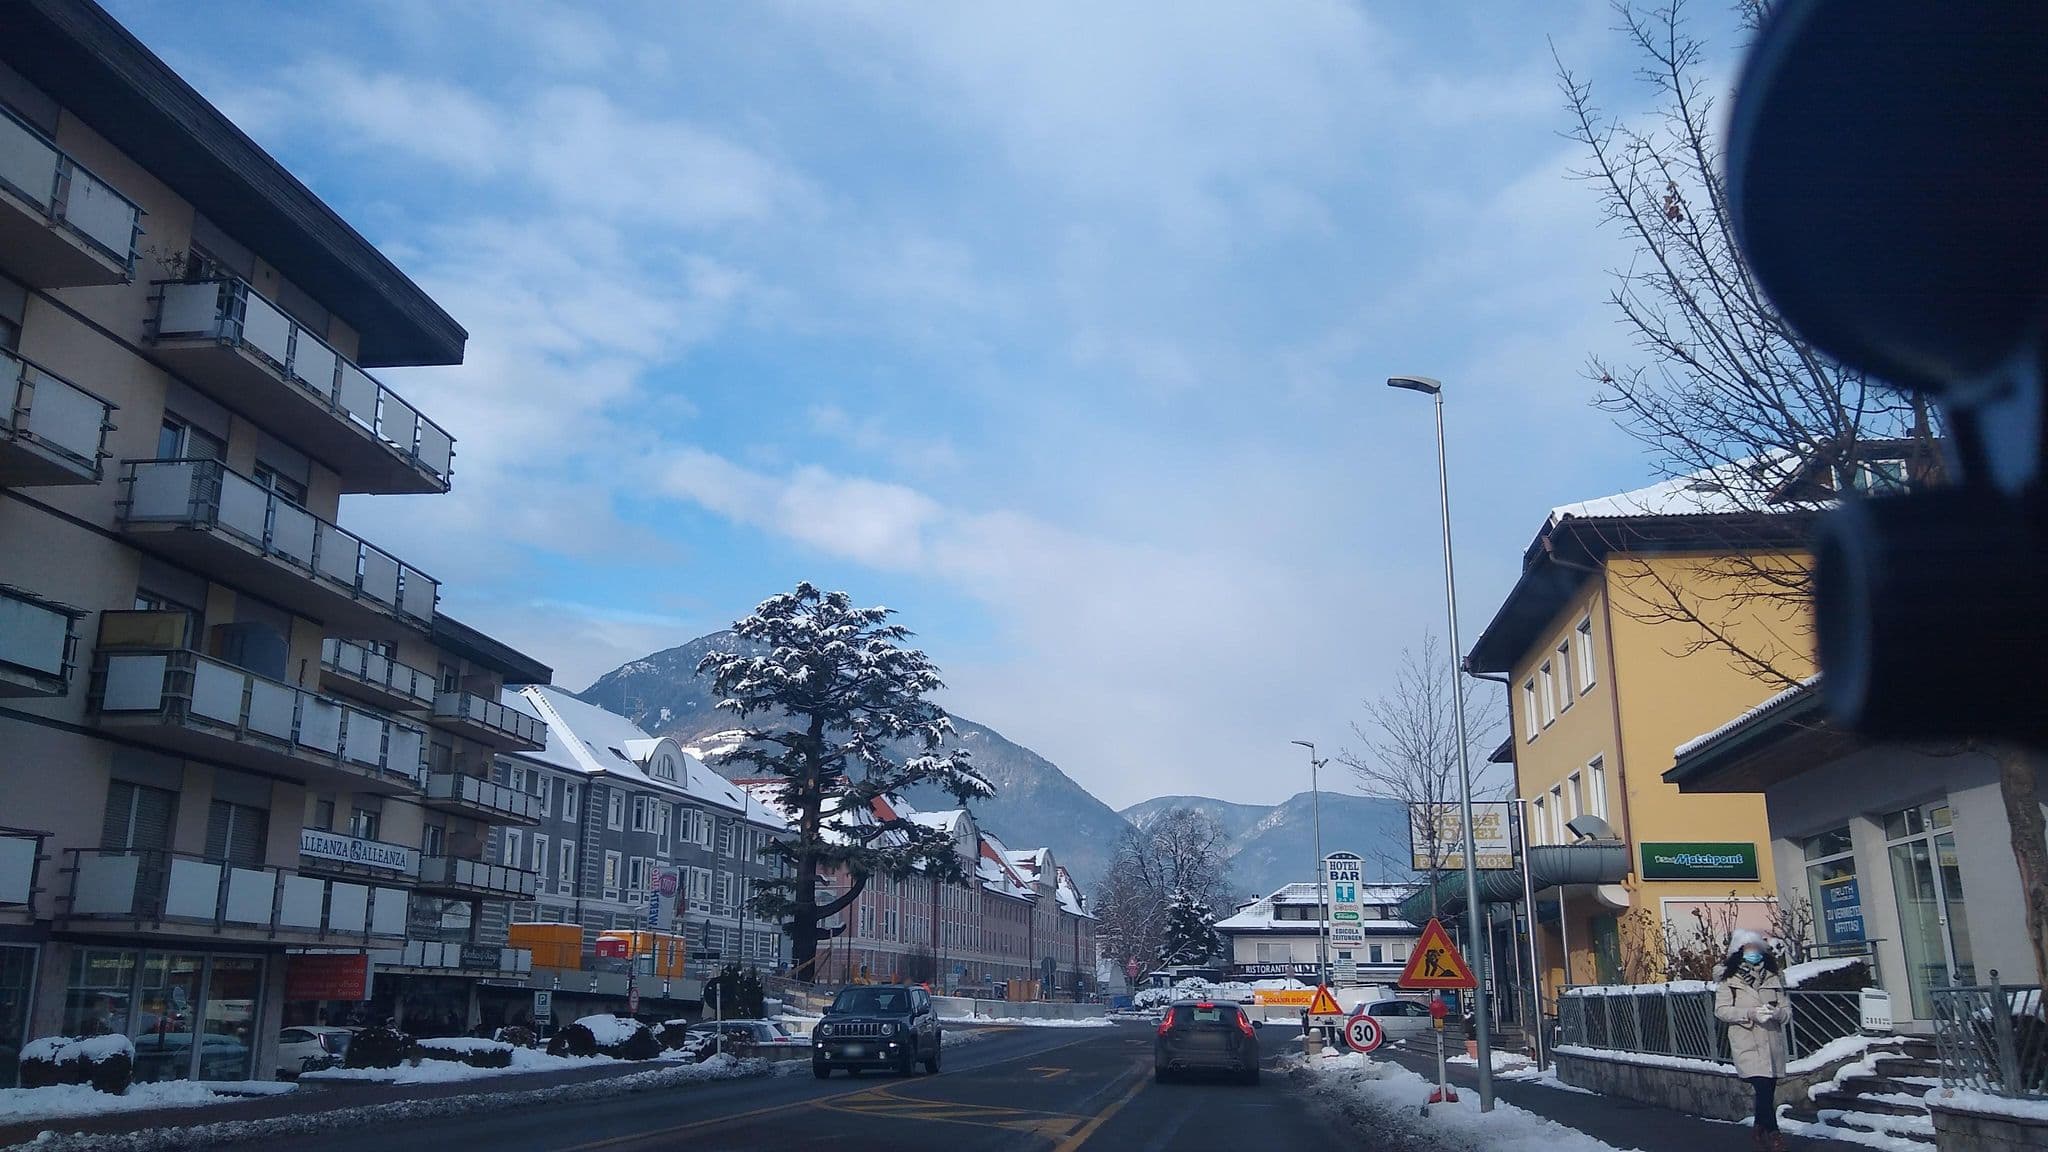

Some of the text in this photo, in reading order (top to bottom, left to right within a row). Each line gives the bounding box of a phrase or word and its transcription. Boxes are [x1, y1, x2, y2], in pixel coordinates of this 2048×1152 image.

[361, 847, 406, 867] ALLEANZA
[1675, 853, 1744, 866] Matchpoint
[1330, 861, 1359, 870] HOTEL
[1330, 871, 1359, 880] BAR
[1354, 1025, 1374, 1041] 30
